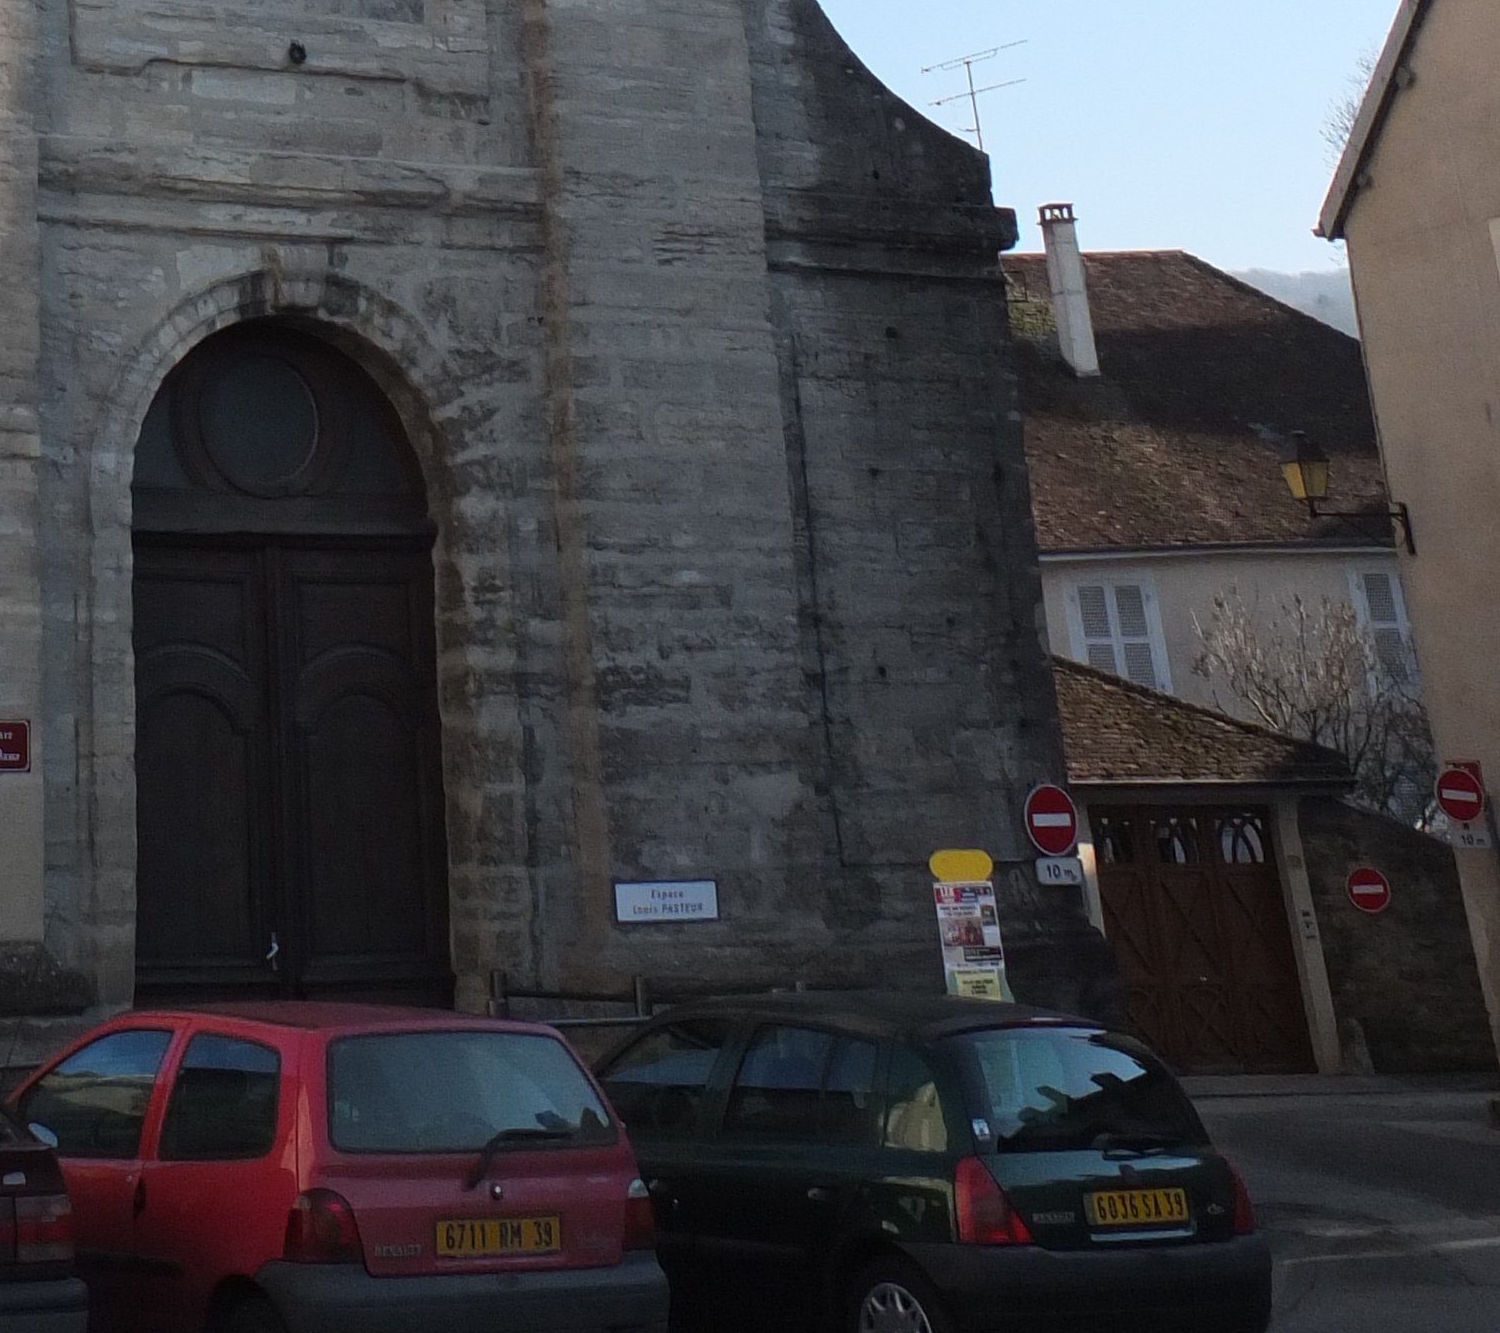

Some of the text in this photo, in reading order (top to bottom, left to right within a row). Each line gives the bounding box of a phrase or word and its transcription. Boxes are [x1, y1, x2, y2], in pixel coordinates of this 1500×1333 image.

[1046, 864, 1061, 878] 10
[661, 902, 703, 913] PASTEUR
[1096, 1193, 1139, 1221] 6036
[1164, 1192, 1184, 1216] 39
[445, 1220, 487, 1249] 6711
[534, 1220, 553, 1247] 39
